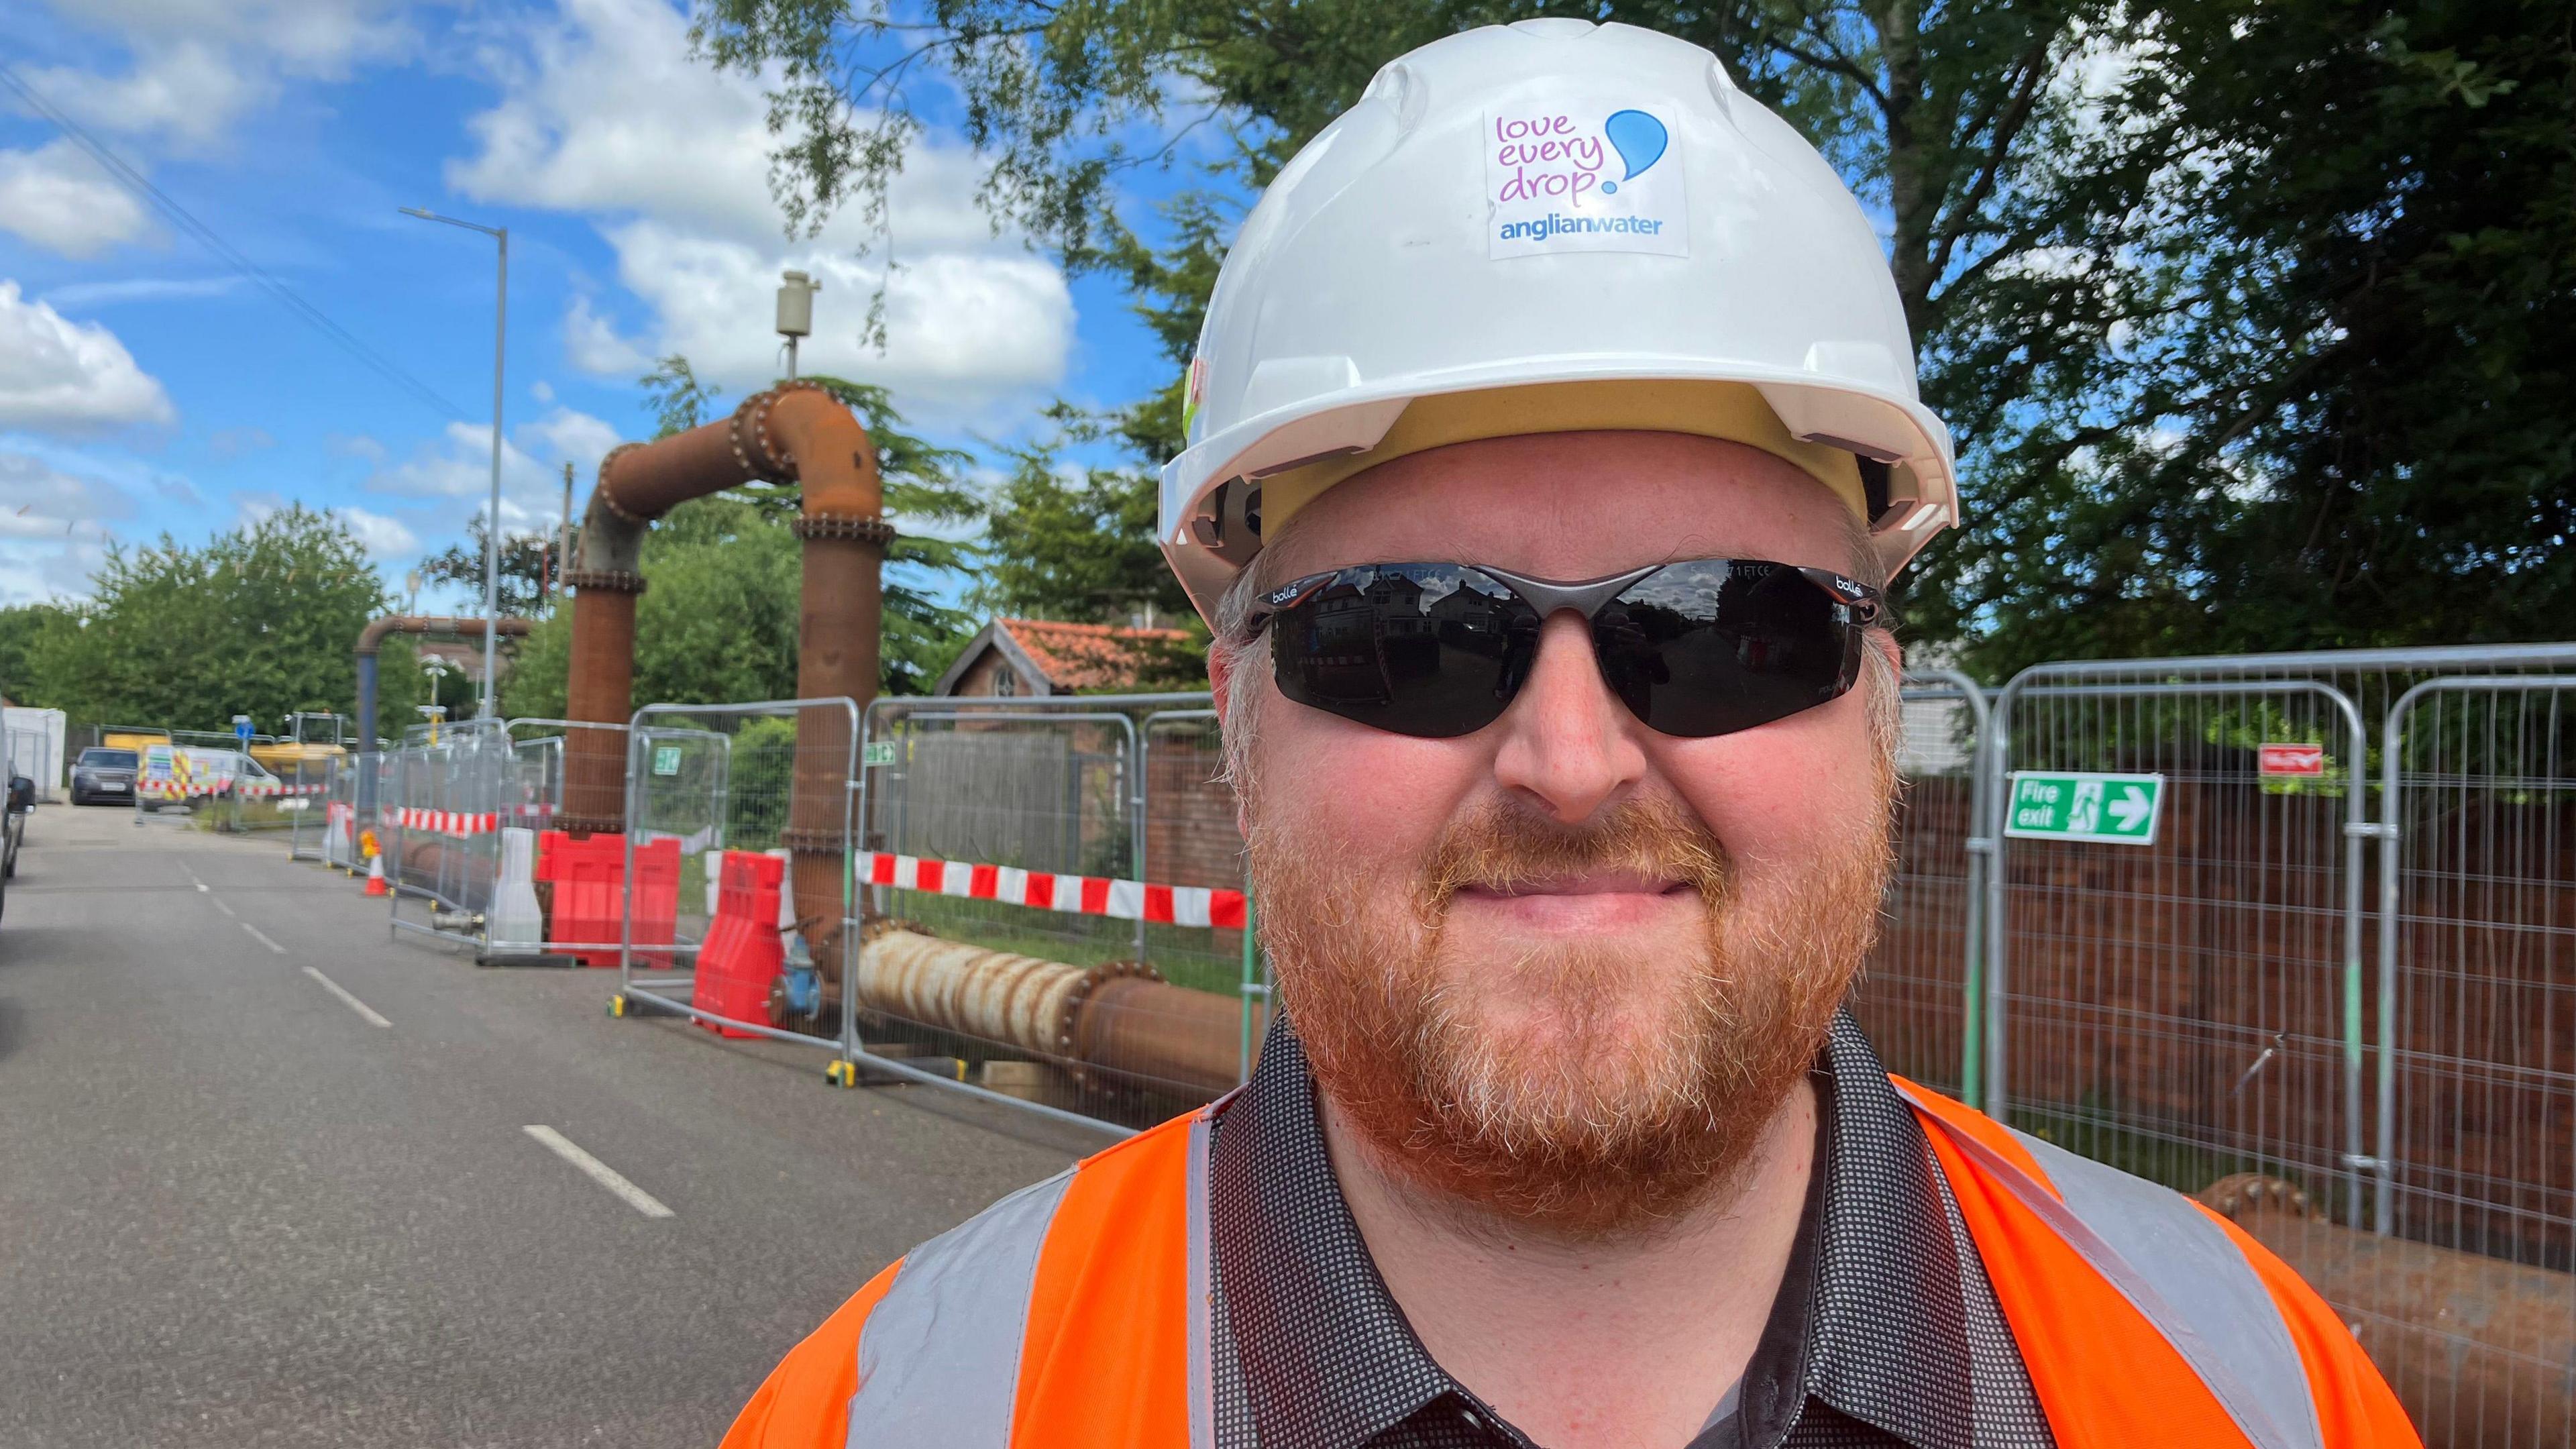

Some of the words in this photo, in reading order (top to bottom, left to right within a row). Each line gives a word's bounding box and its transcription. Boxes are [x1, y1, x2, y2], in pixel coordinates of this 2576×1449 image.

[1496, 115, 1576, 142] love
[1498, 136, 1604, 171] every
[1500, 213, 1663, 241] anglianwater
[1273, 584, 1297, 604] bollé
[1835, 574, 1864, 598] bollé
[2021, 780, 2060, 804] Fire
[2017, 805, 2055, 827] exit
